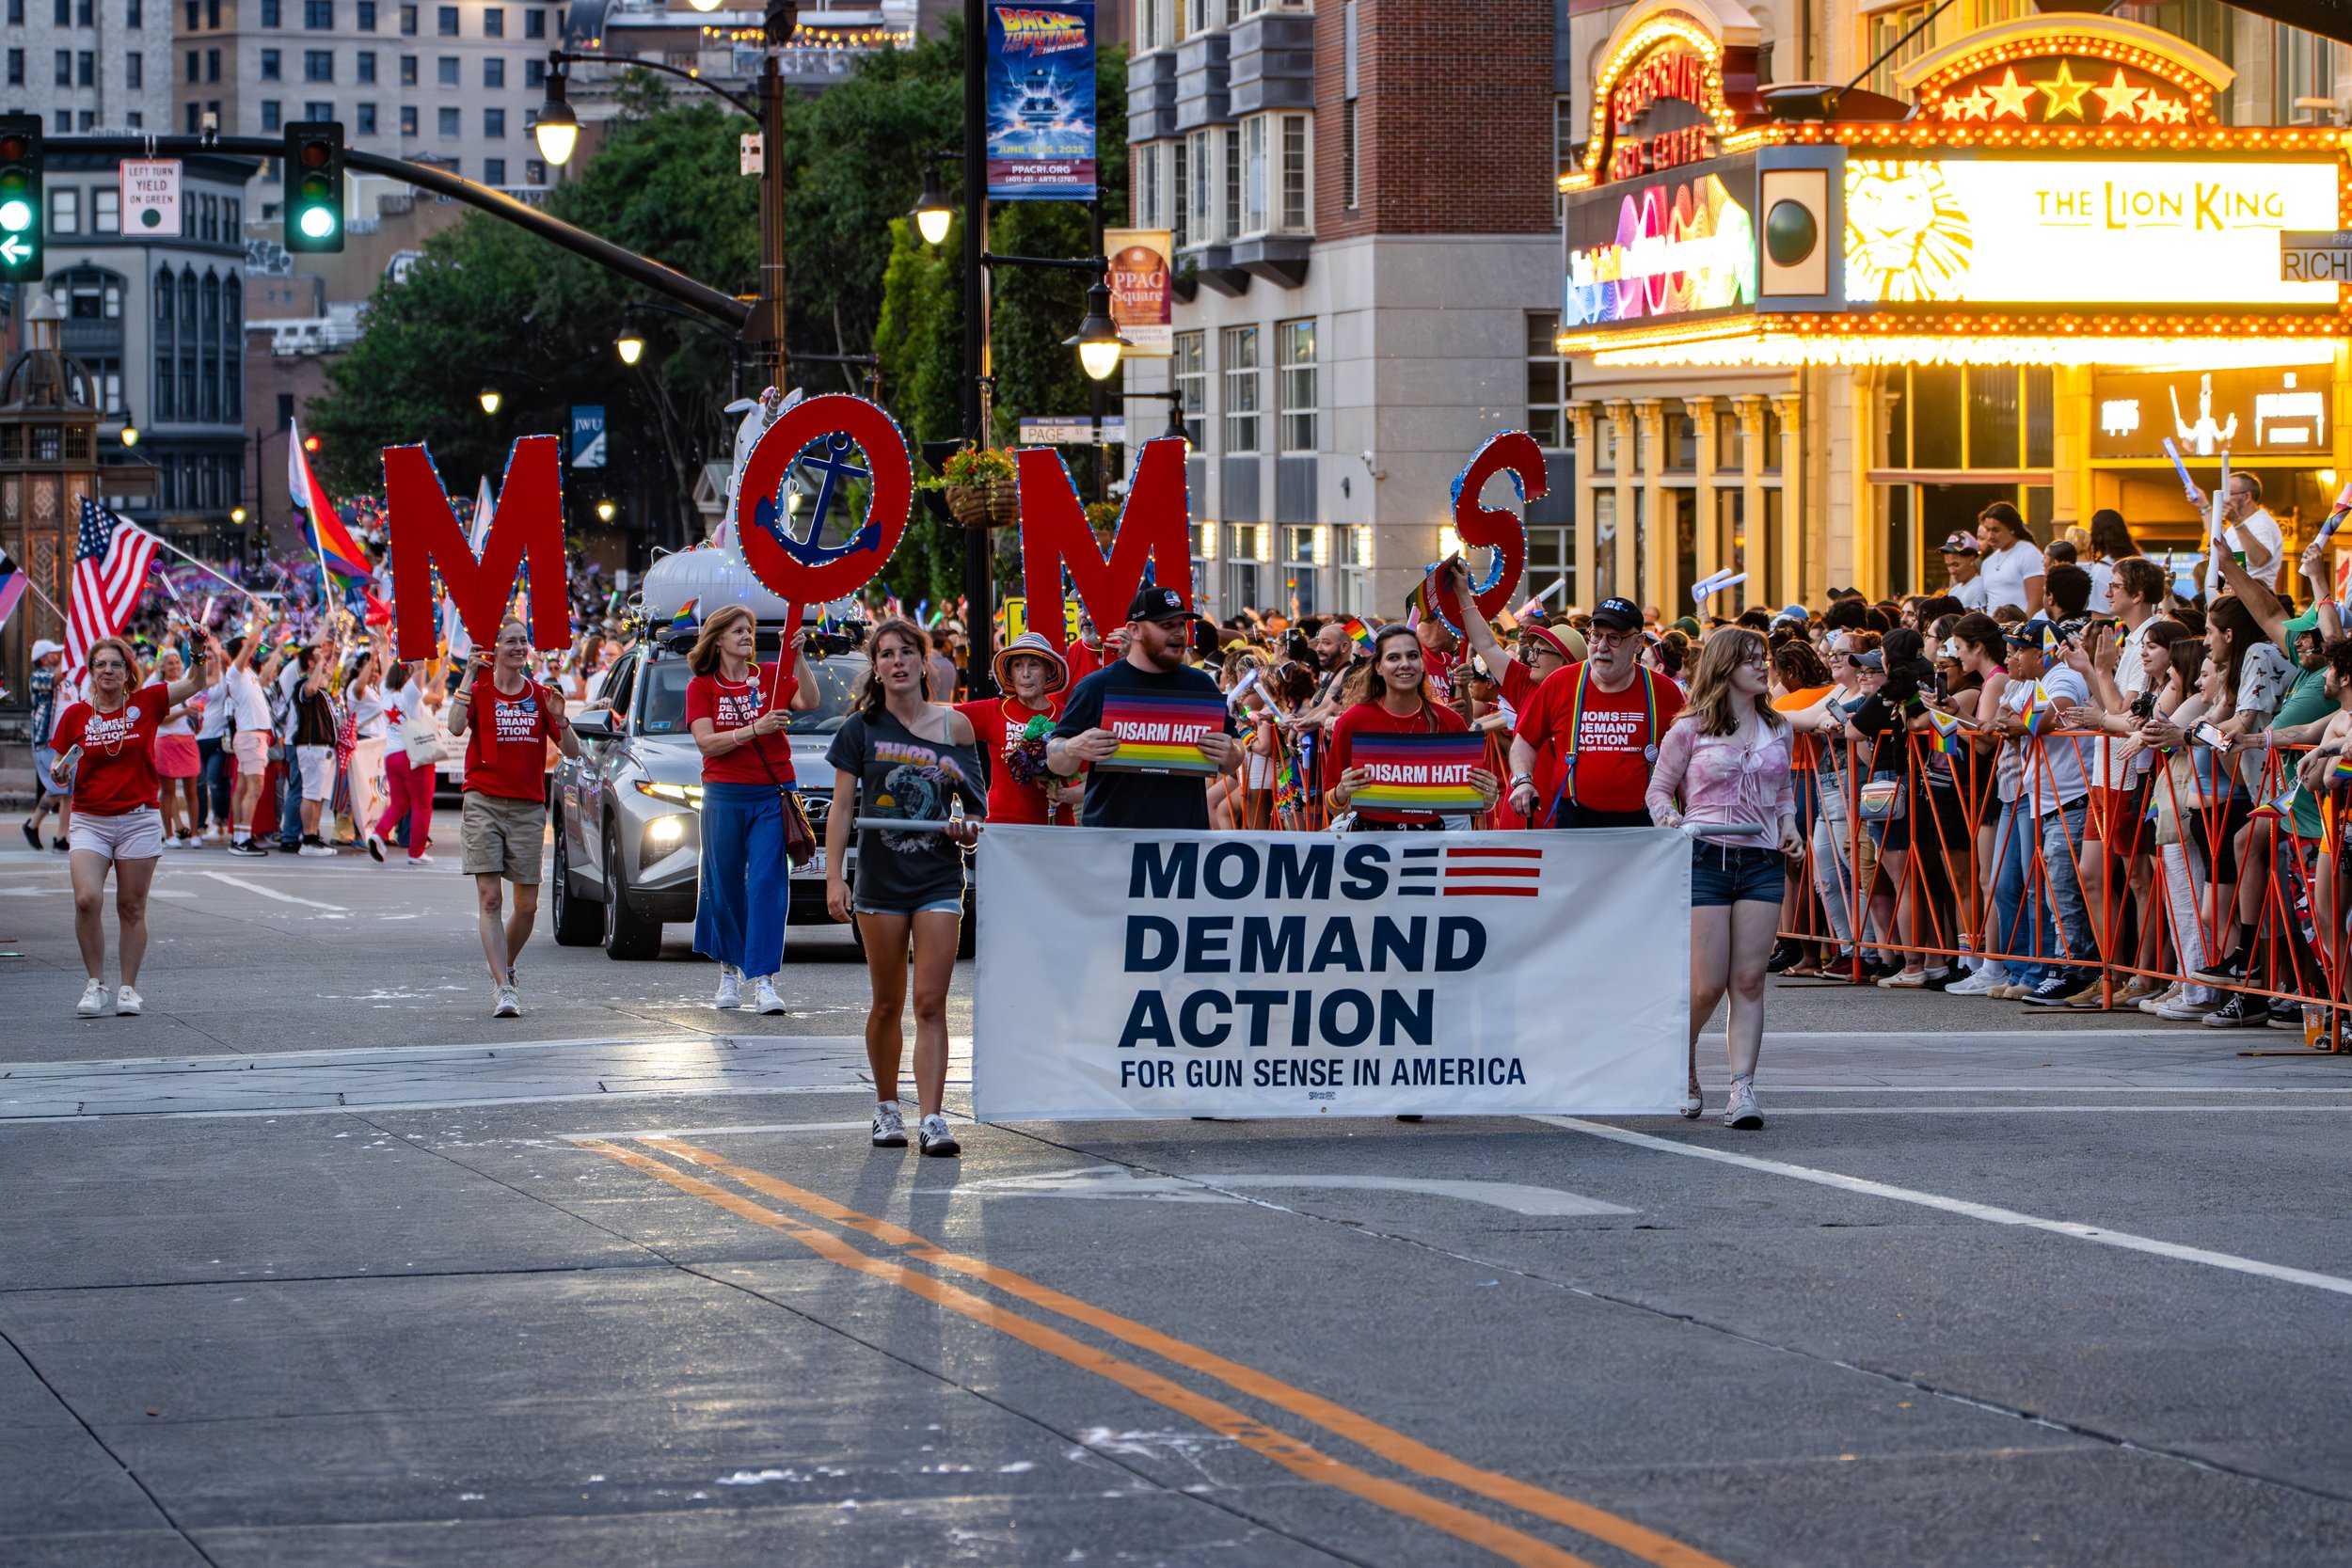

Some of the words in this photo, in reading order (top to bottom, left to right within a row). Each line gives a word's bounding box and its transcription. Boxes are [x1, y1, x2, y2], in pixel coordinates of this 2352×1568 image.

[995, 7, 1074, 31] BACK
[1004, 31, 1023, 42] TO
[1022, 28, 1086, 49] FUTURE
[997, 146, 1025, 154] JUNE
[1058, 146, 1085, 154] 2025
[129, 167, 149, 177] LEFT
[152, 167, 173, 177] TURN
[1011, 166, 1071, 174] PPACRI.ORG
[136, 180, 167, 192] YIELD
[130, 195, 141, 204] ON
[145, 195, 173, 204] GREEN
[2035, 191, 2092, 215] THE
[2105, 182, 2183, 230] LION
[2195, 182, 2283, 231] KING
[2284, 252, 2352, 280] RICH
[1114, 272, 1163, 289] PPAC
[1113, 290, 1164, 307] Square
[573, 418, 603, 433] JWU
[1028, 428, 1065, 442] PAGE
[720, 695, 749, 705] MMS
[496, 709, 521, 718] OMS
[717, 709, 759, 721] ACTON
[85, 718, 119, 733] MMS
[85, 722, 134, 736] MAND
[496, 718, 535, 726] EMAND
[496, 726, 531, 736] CTION
[1112, 721, 1170, 742] DISARM
[1364, 763, 1428, 784] DISARM
[1431, 764, 1472, 784] HATE
[1128, 842, 1391, 900] MOMS
[1124, 914, 1487, 974] DEMAND
[1117, 989, 1435, 1048] ACTION
[1120, 1059, 1175, 1088] FOR
[1185, 1059, 1243, 1088] GUN
[1253, 1058, 1344, 1087] SENSE
[1352, 1058, 1380, 1086] IN
[1391, 1057, 1527, 1085] AMERICA
